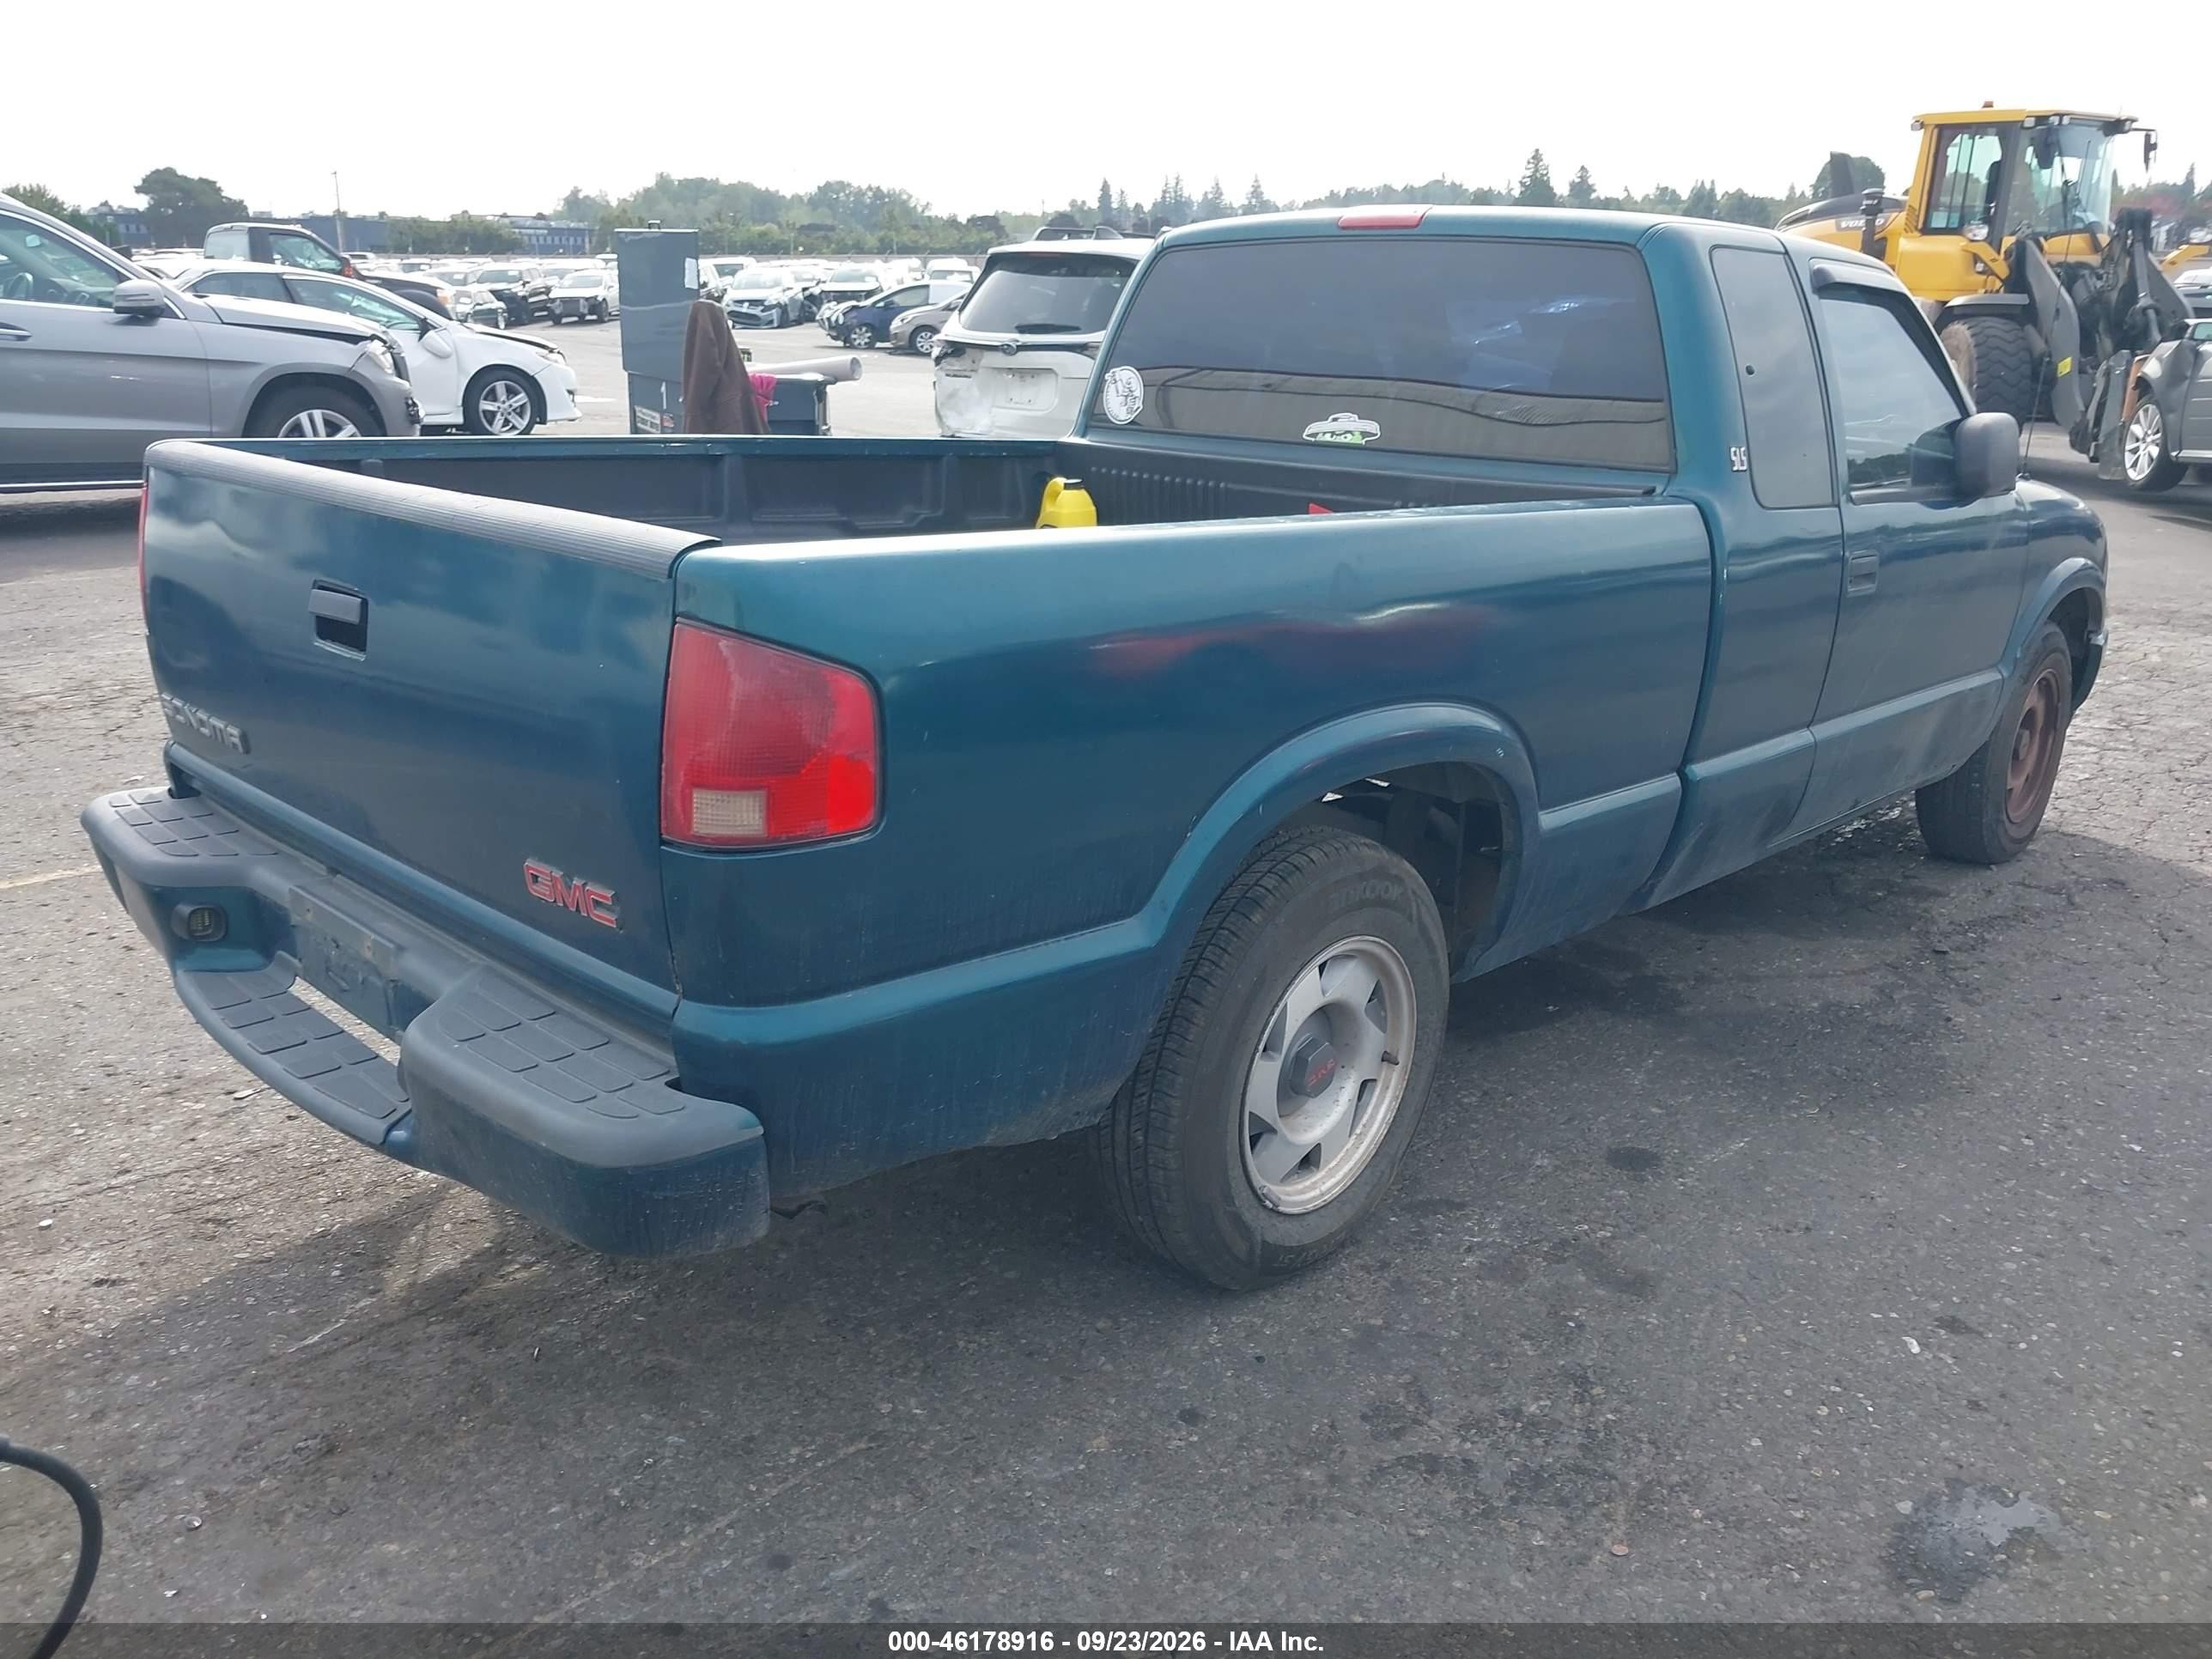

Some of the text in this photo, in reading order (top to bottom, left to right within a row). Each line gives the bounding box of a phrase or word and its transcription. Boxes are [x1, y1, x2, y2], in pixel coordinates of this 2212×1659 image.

[1840, 218, 1886, 228] VOLO
[660, 380, 667, 410] 1
[161, 692, 245, 754] SONOMA
[523, 859, 617, 928] GMC
